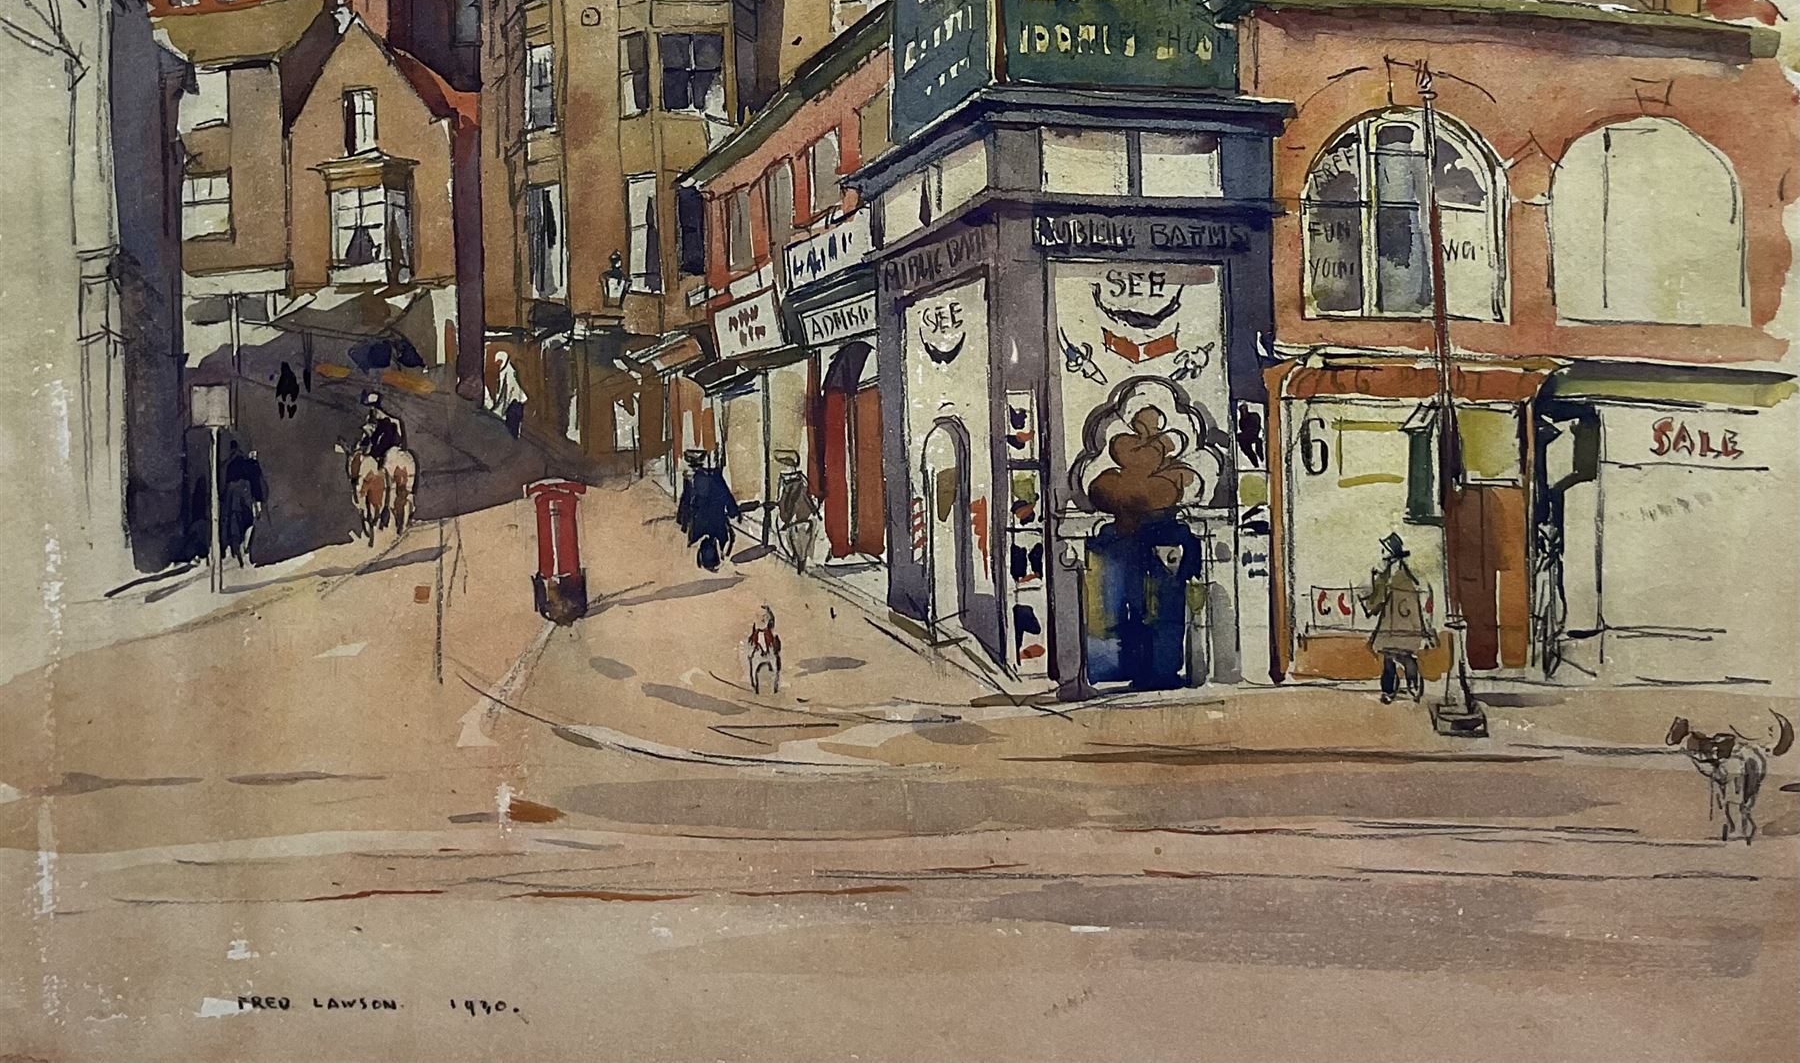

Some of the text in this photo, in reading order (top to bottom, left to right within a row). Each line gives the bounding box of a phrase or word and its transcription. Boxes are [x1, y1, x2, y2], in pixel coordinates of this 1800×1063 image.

[1105, 268, 1167, 298] SEE
[921, 302, 964, 334] SEE
[1650, 416, 1744, 460] SALE
[237, 996, 290, 1010] FRED
